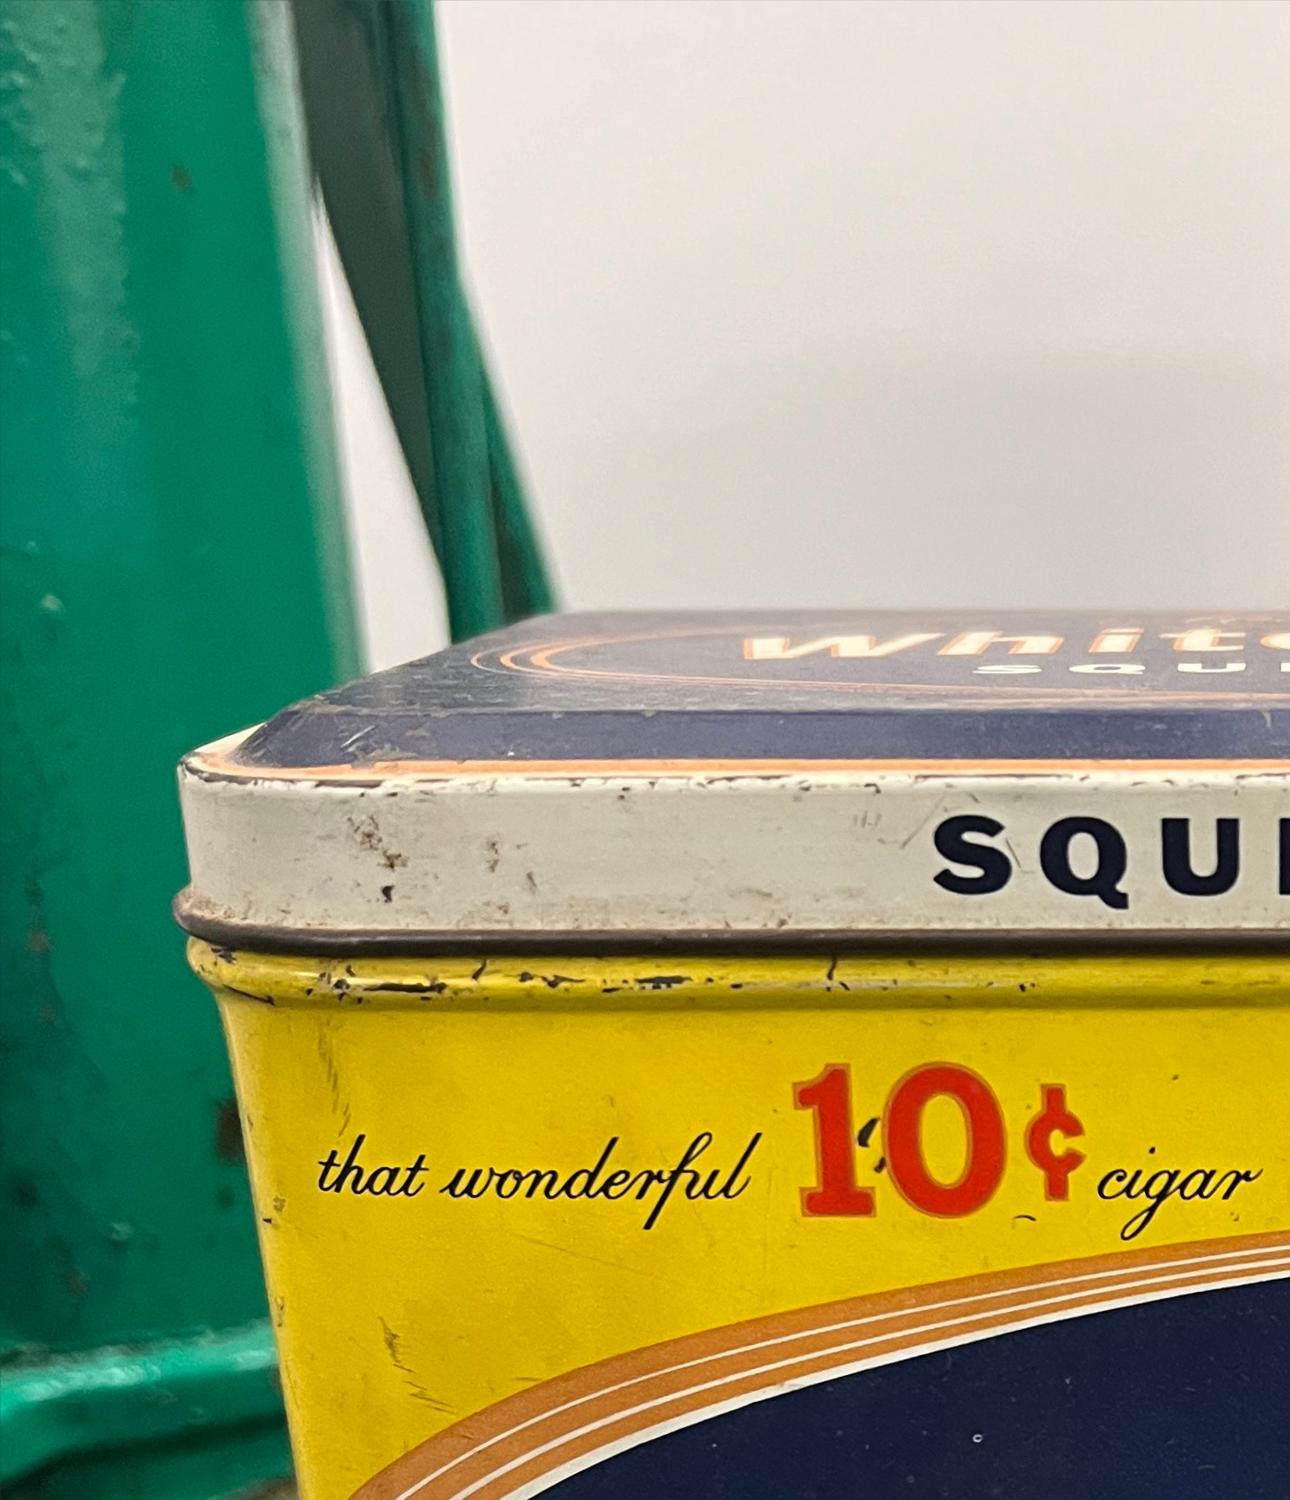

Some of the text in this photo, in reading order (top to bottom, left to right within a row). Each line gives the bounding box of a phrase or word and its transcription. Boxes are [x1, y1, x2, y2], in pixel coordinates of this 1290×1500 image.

[317, 1134, 431, 1198] that
[439, 1131, 763, 1231] wonderful
[1096, 1145, 1265, 1240] cigar
